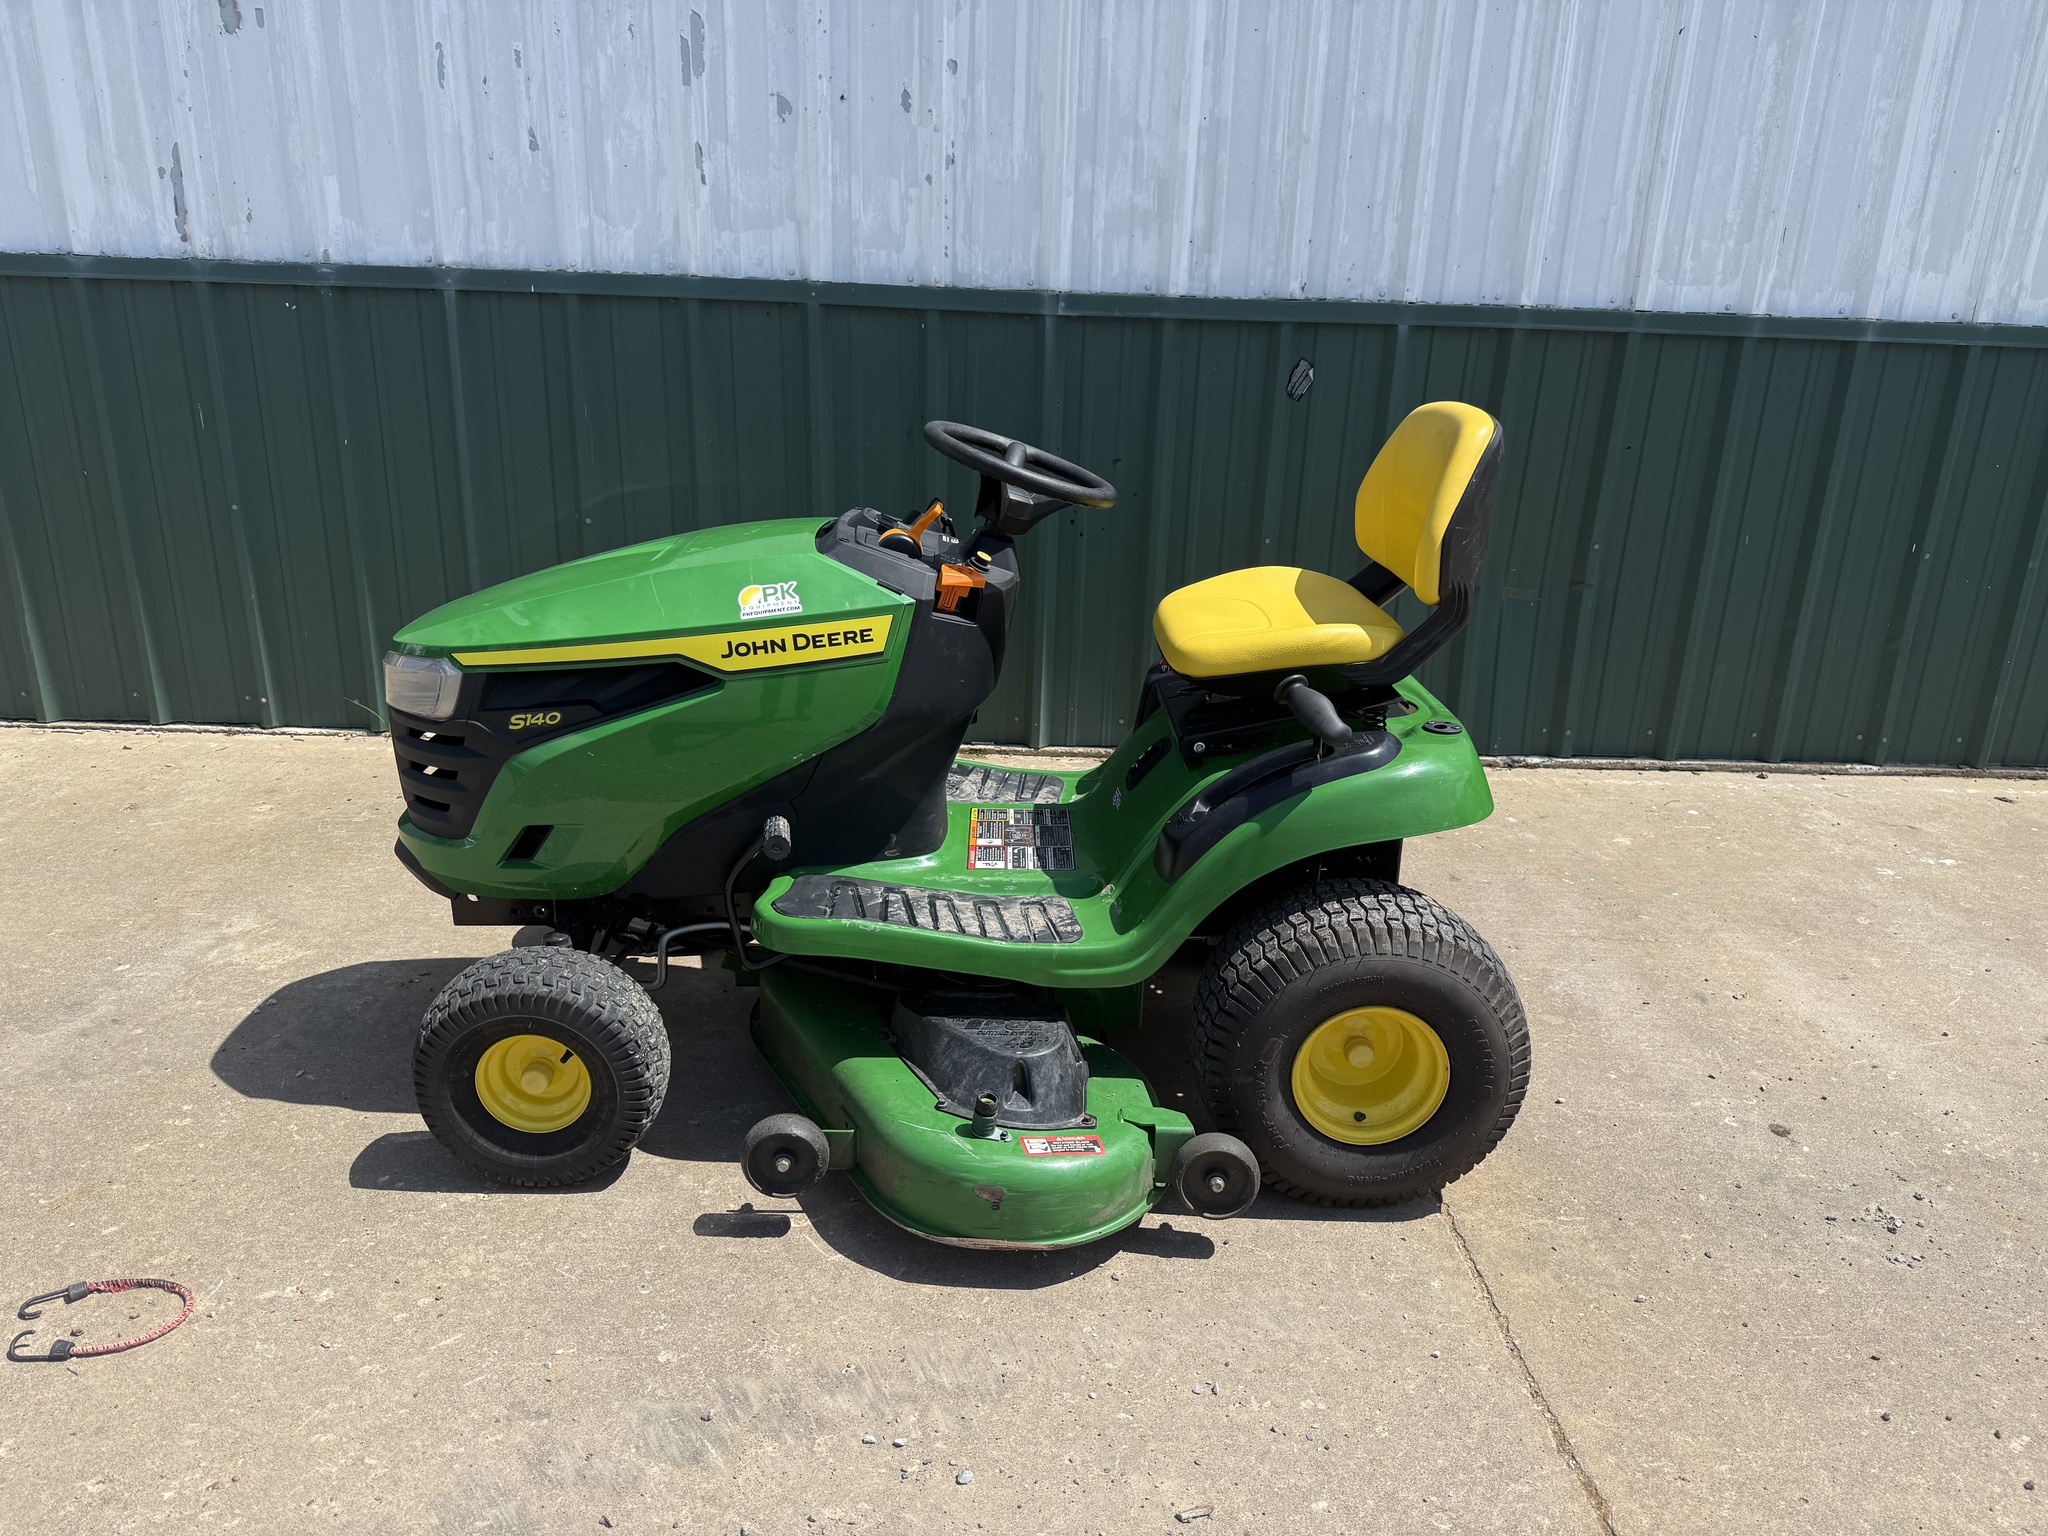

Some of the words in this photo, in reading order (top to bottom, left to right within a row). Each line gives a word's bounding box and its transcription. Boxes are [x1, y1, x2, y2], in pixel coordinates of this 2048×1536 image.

[742, 605, 801, 616] PKEQUIPMENT.COM
[721, 638, 787, 659] JOHN
[792, 628, 874, 651] DEERE
[508, 711, 561, 730] S140
